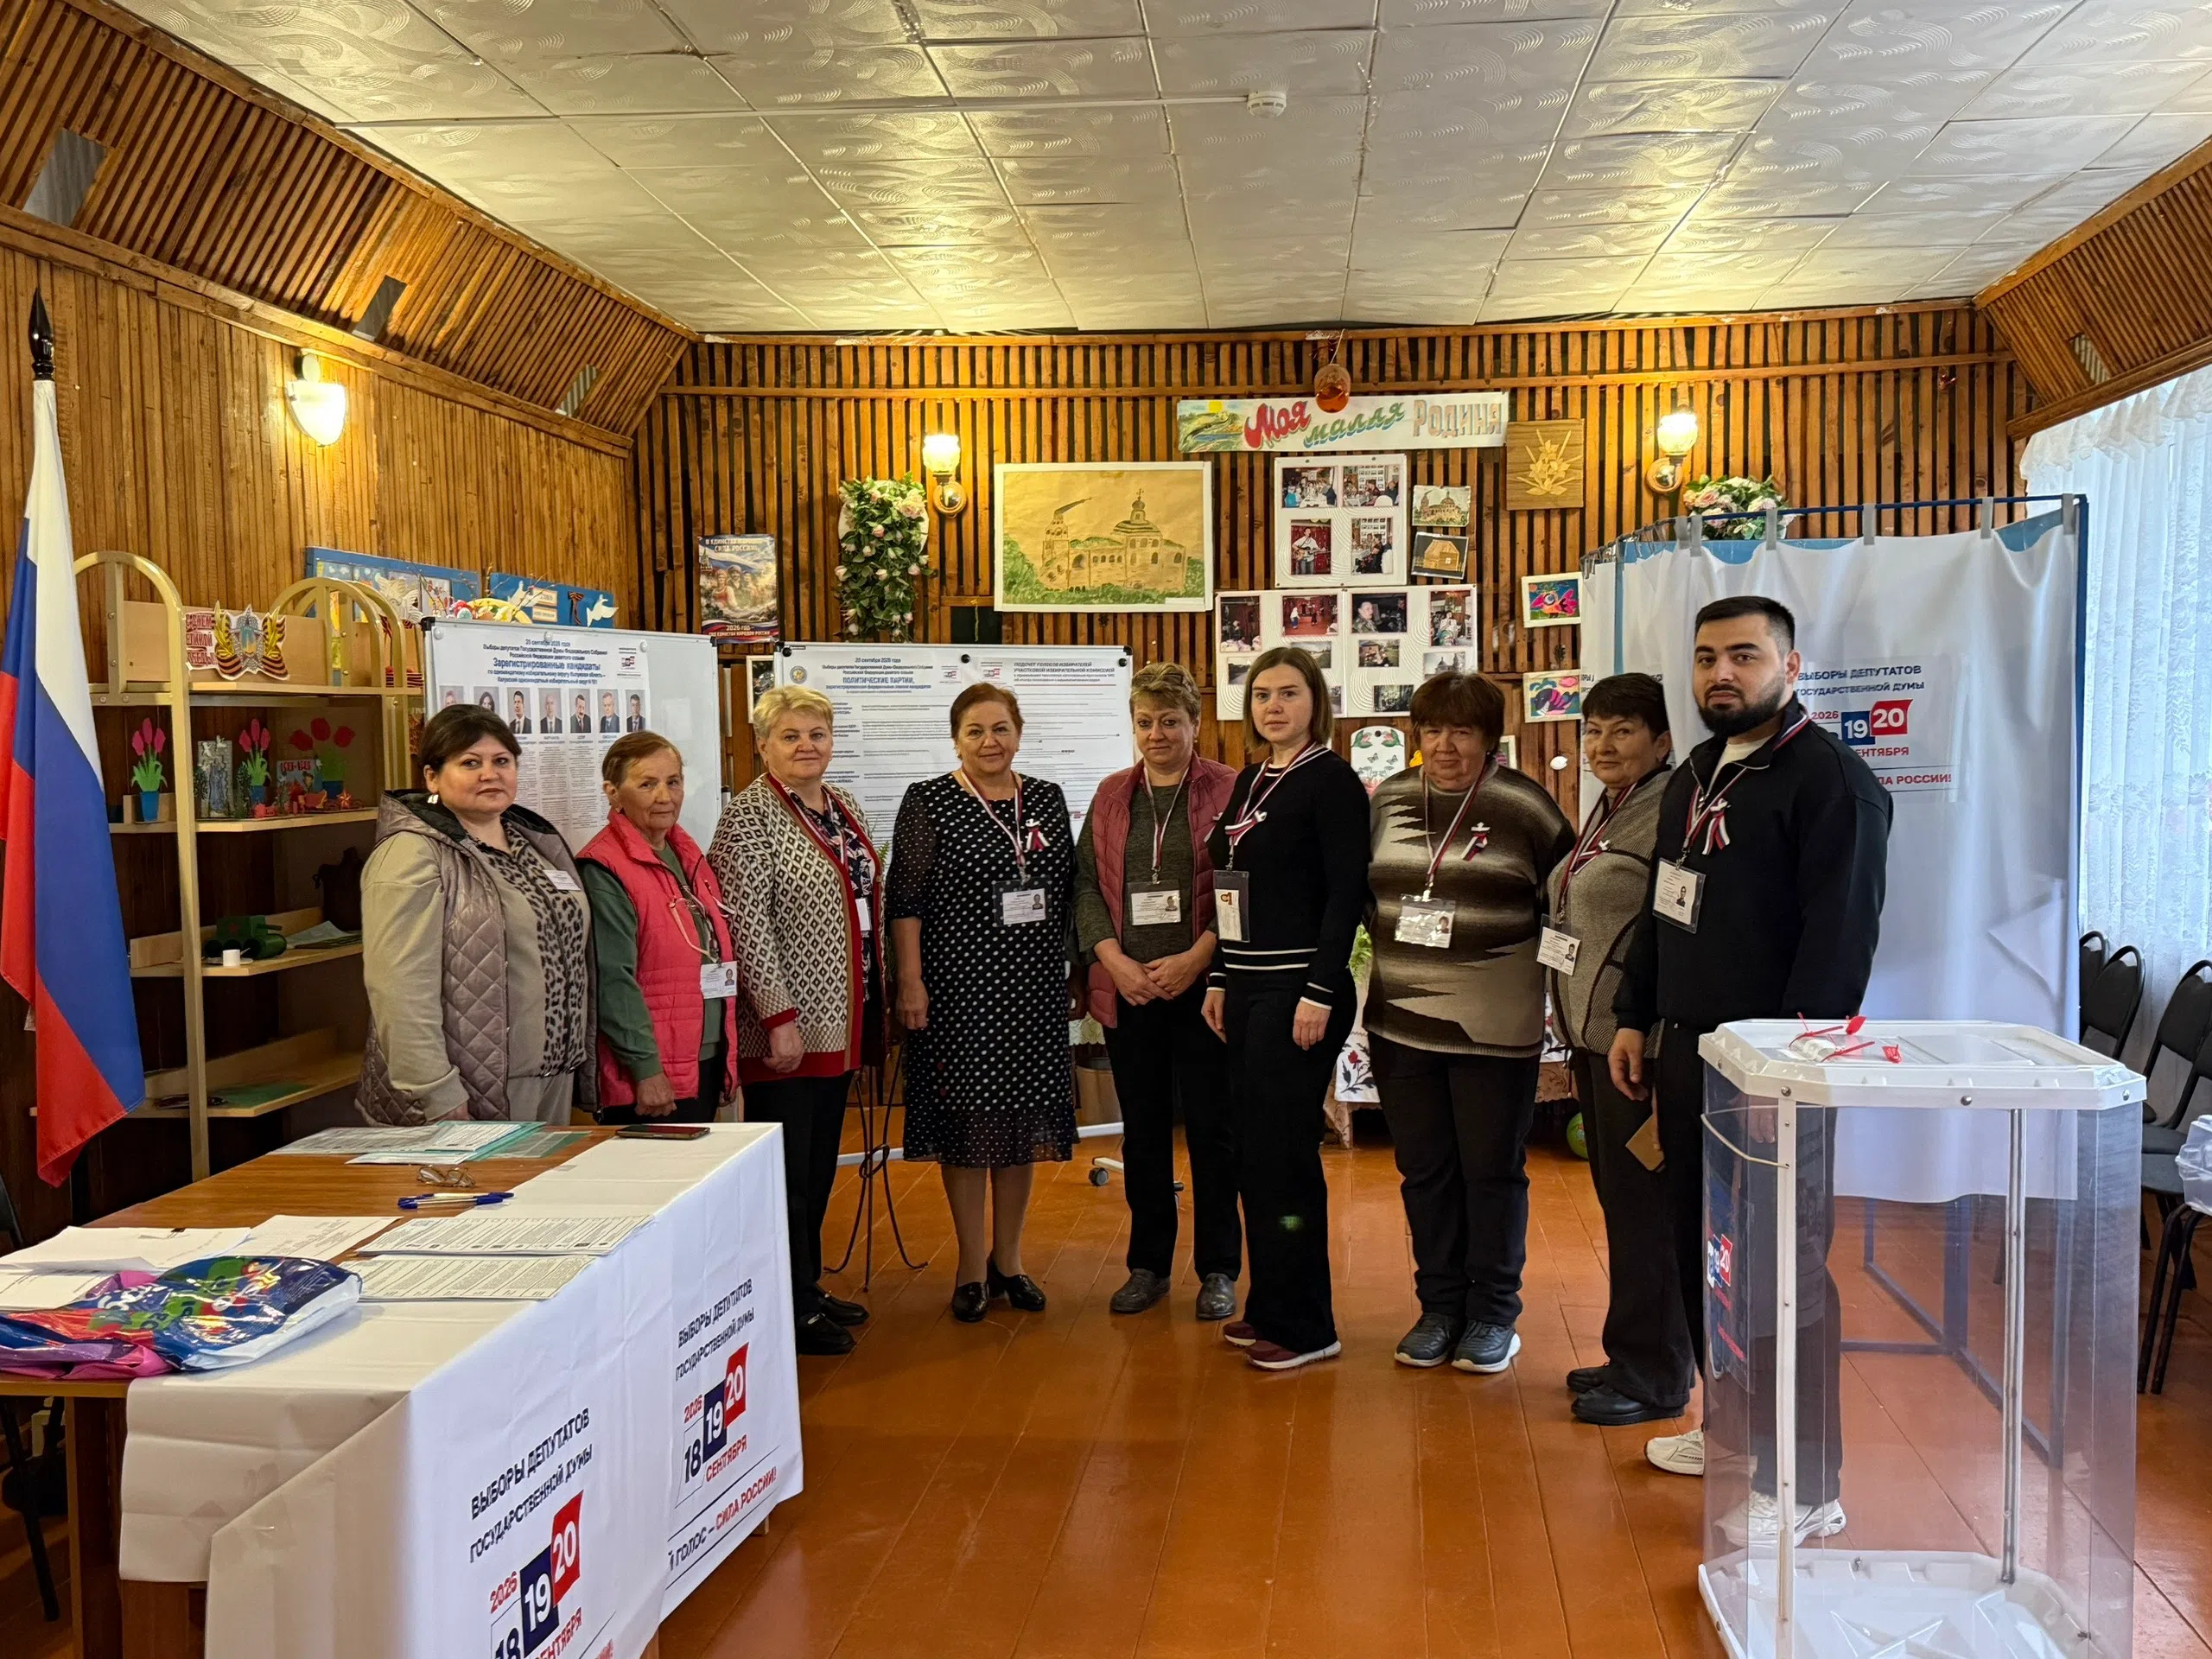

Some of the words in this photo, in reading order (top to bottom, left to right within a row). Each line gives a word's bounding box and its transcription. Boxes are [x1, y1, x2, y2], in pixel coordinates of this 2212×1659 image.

[1243, 400, 1313, 450] Моя
[1303, 401, 1406, 448] малая
[493, 658, 565, 669] Зарегистрированные
[566, 663, 601, 671] кандидаты
[1798, 670, 1847, 681] ВЫБОРЫ
[1850, 665, 1922, 679] ДЕПУТАТОВ
[1892, 682, 1925, 692] ДУМЫ
[1812, 710, 1840, 720] 2026
[1844, 719, 1868, 739] 19
[1872, 708, 1904, 728] 20
[1855, 747, 1910, 757] ЕНТЯБРЯ
[1897, 773, 1952, 785] РОССИИ!
[678, 1308, 712, 1349] ВЫБОРЫ
[712, 1278, 753, 1325] ДЕПУТАТОВ
[676, 1318, 737, 1382] ГОСУДАРСТВЕННОЙ
[737, 1306, 755, 1333] ДУМЫ
[683, 1394, 702, 1424] 2026
[684, 1439, 702, 1484] 18
[705, 1400, 723, 1446] 19
[725, 1364, 743, 1411] 20
[471, 1458, 525, 1520] ВЫБОРЫ
[527, 1408, 589, 1478] ДЕПУТАТОВ
[706, 1433, 747, 1483] СЕНТЯБРЯ
[470, 1463, 563, 1563] ГОСУДАРСТВЕННОЙ
[565, 1443, 593, 1483] ДУМЫ
[676, 1526, 707, 1567] ГОЛОС
[715, 1498, 740, 1530] СИЛА
[741, 1466, 777, 1509] РОССИИ!
[490, 1571, 518, 1614] 2026
[524, 1573, 552, 1632] 19
[552, 1521, 577, 1584] 20
[535, 1606, 582, 1659] ЕНТЯБРЯ
